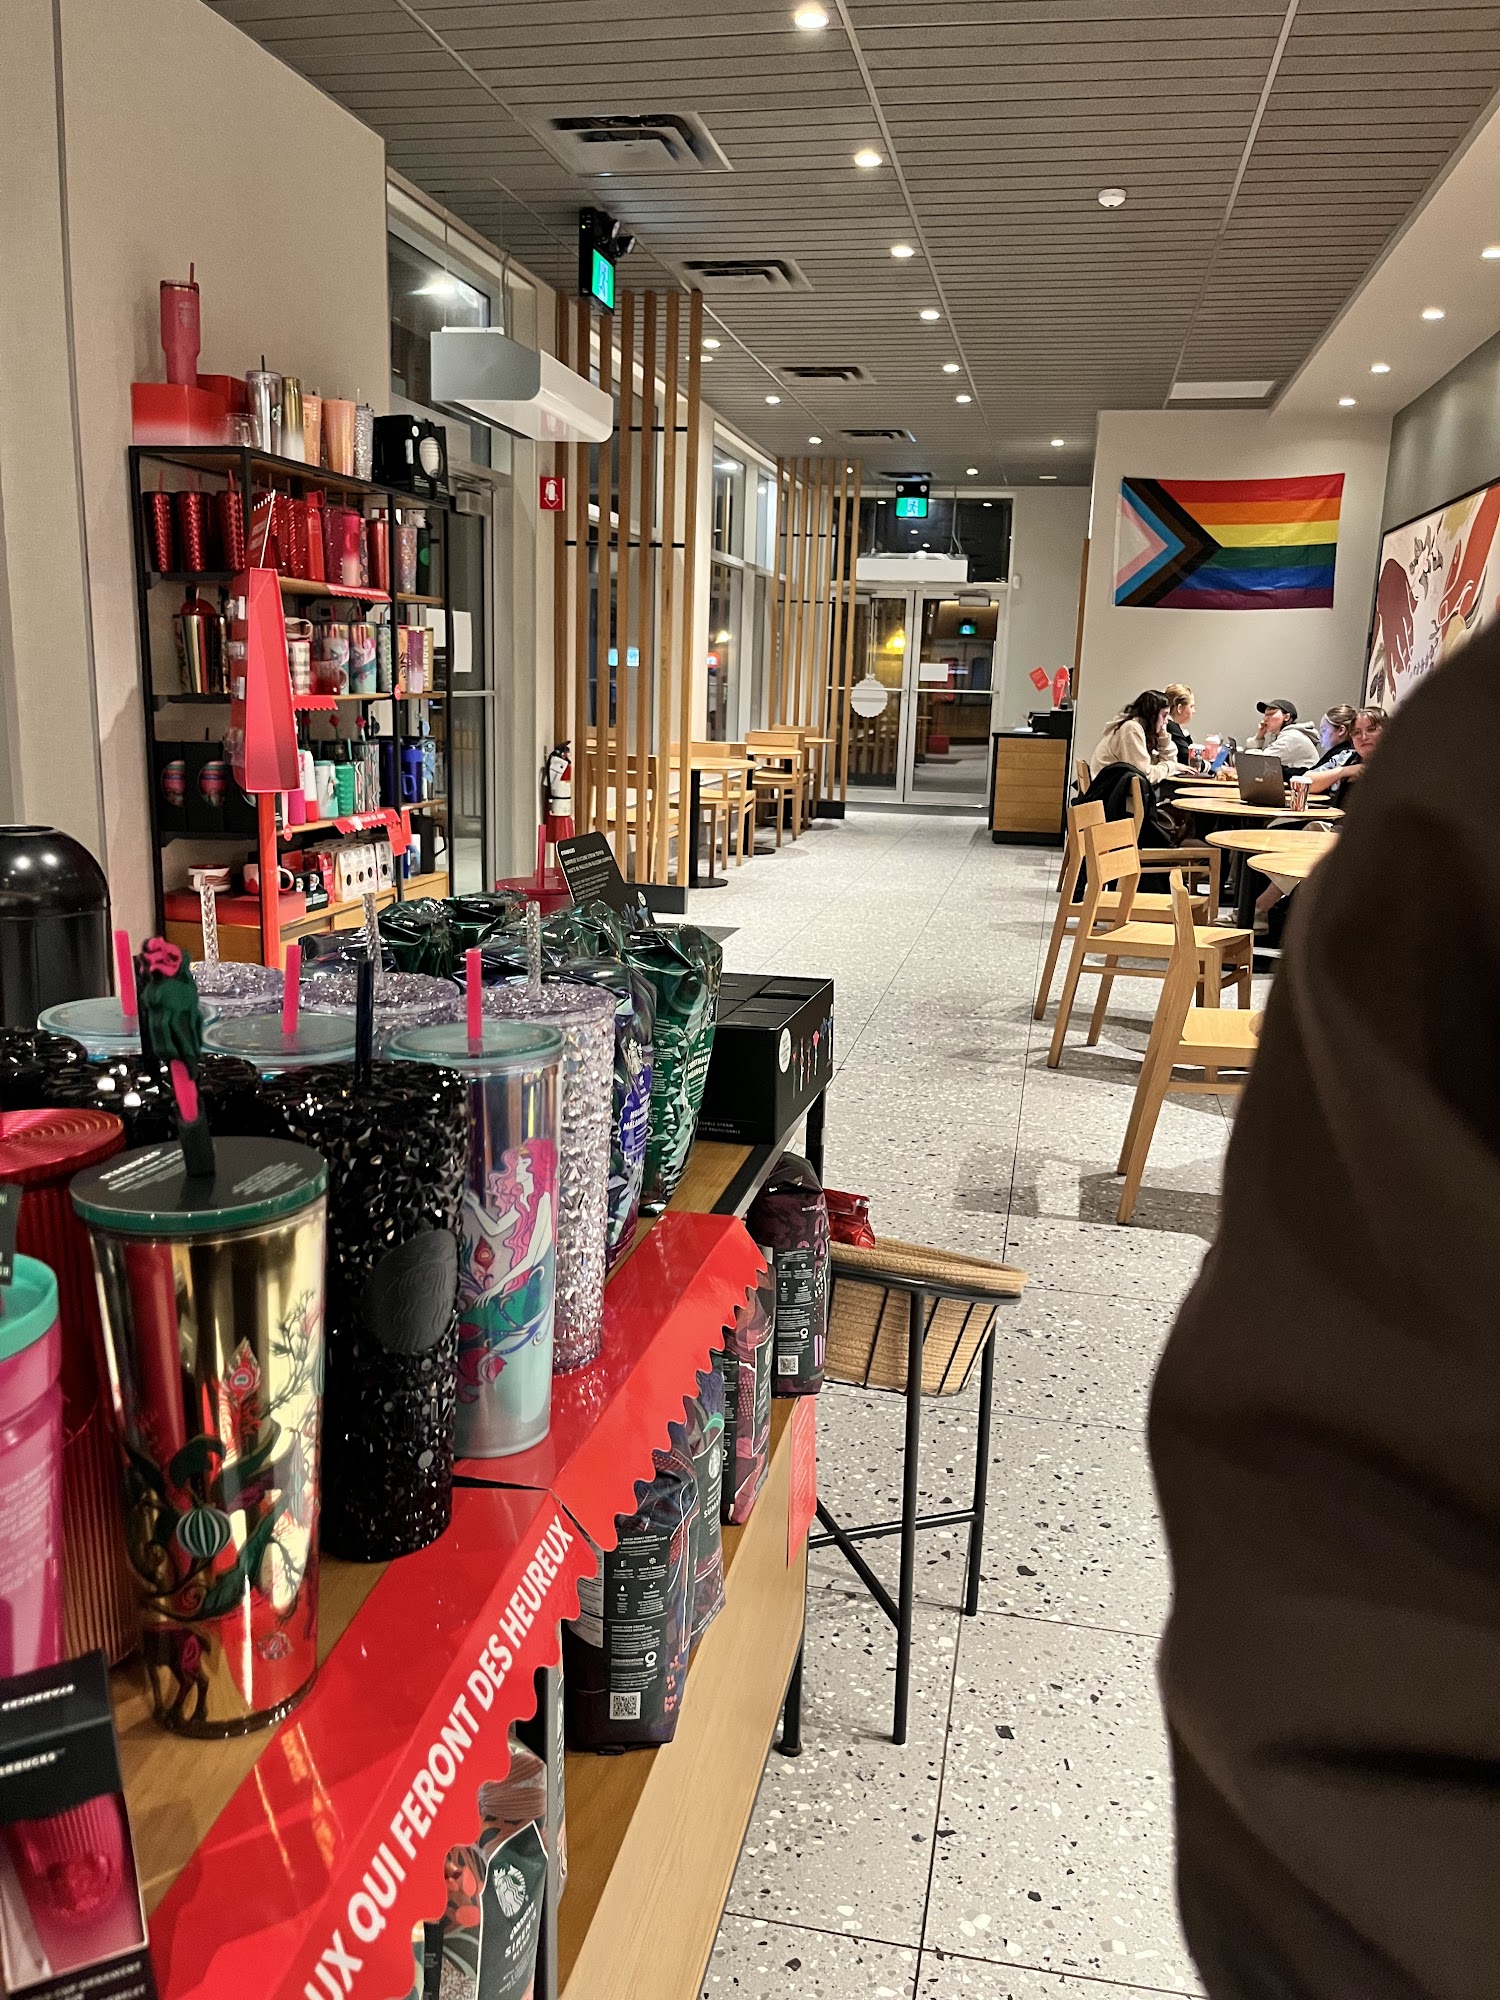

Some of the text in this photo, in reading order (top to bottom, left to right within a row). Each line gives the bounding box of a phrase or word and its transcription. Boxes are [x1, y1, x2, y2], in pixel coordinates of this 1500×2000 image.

[347, 1842, 406, 1943] QUI
[389, 1692, 480, 1860] FERONT
[466, 1633, 513, 1712] DES
[498, 1514, 574, 1649] HEUREUX
